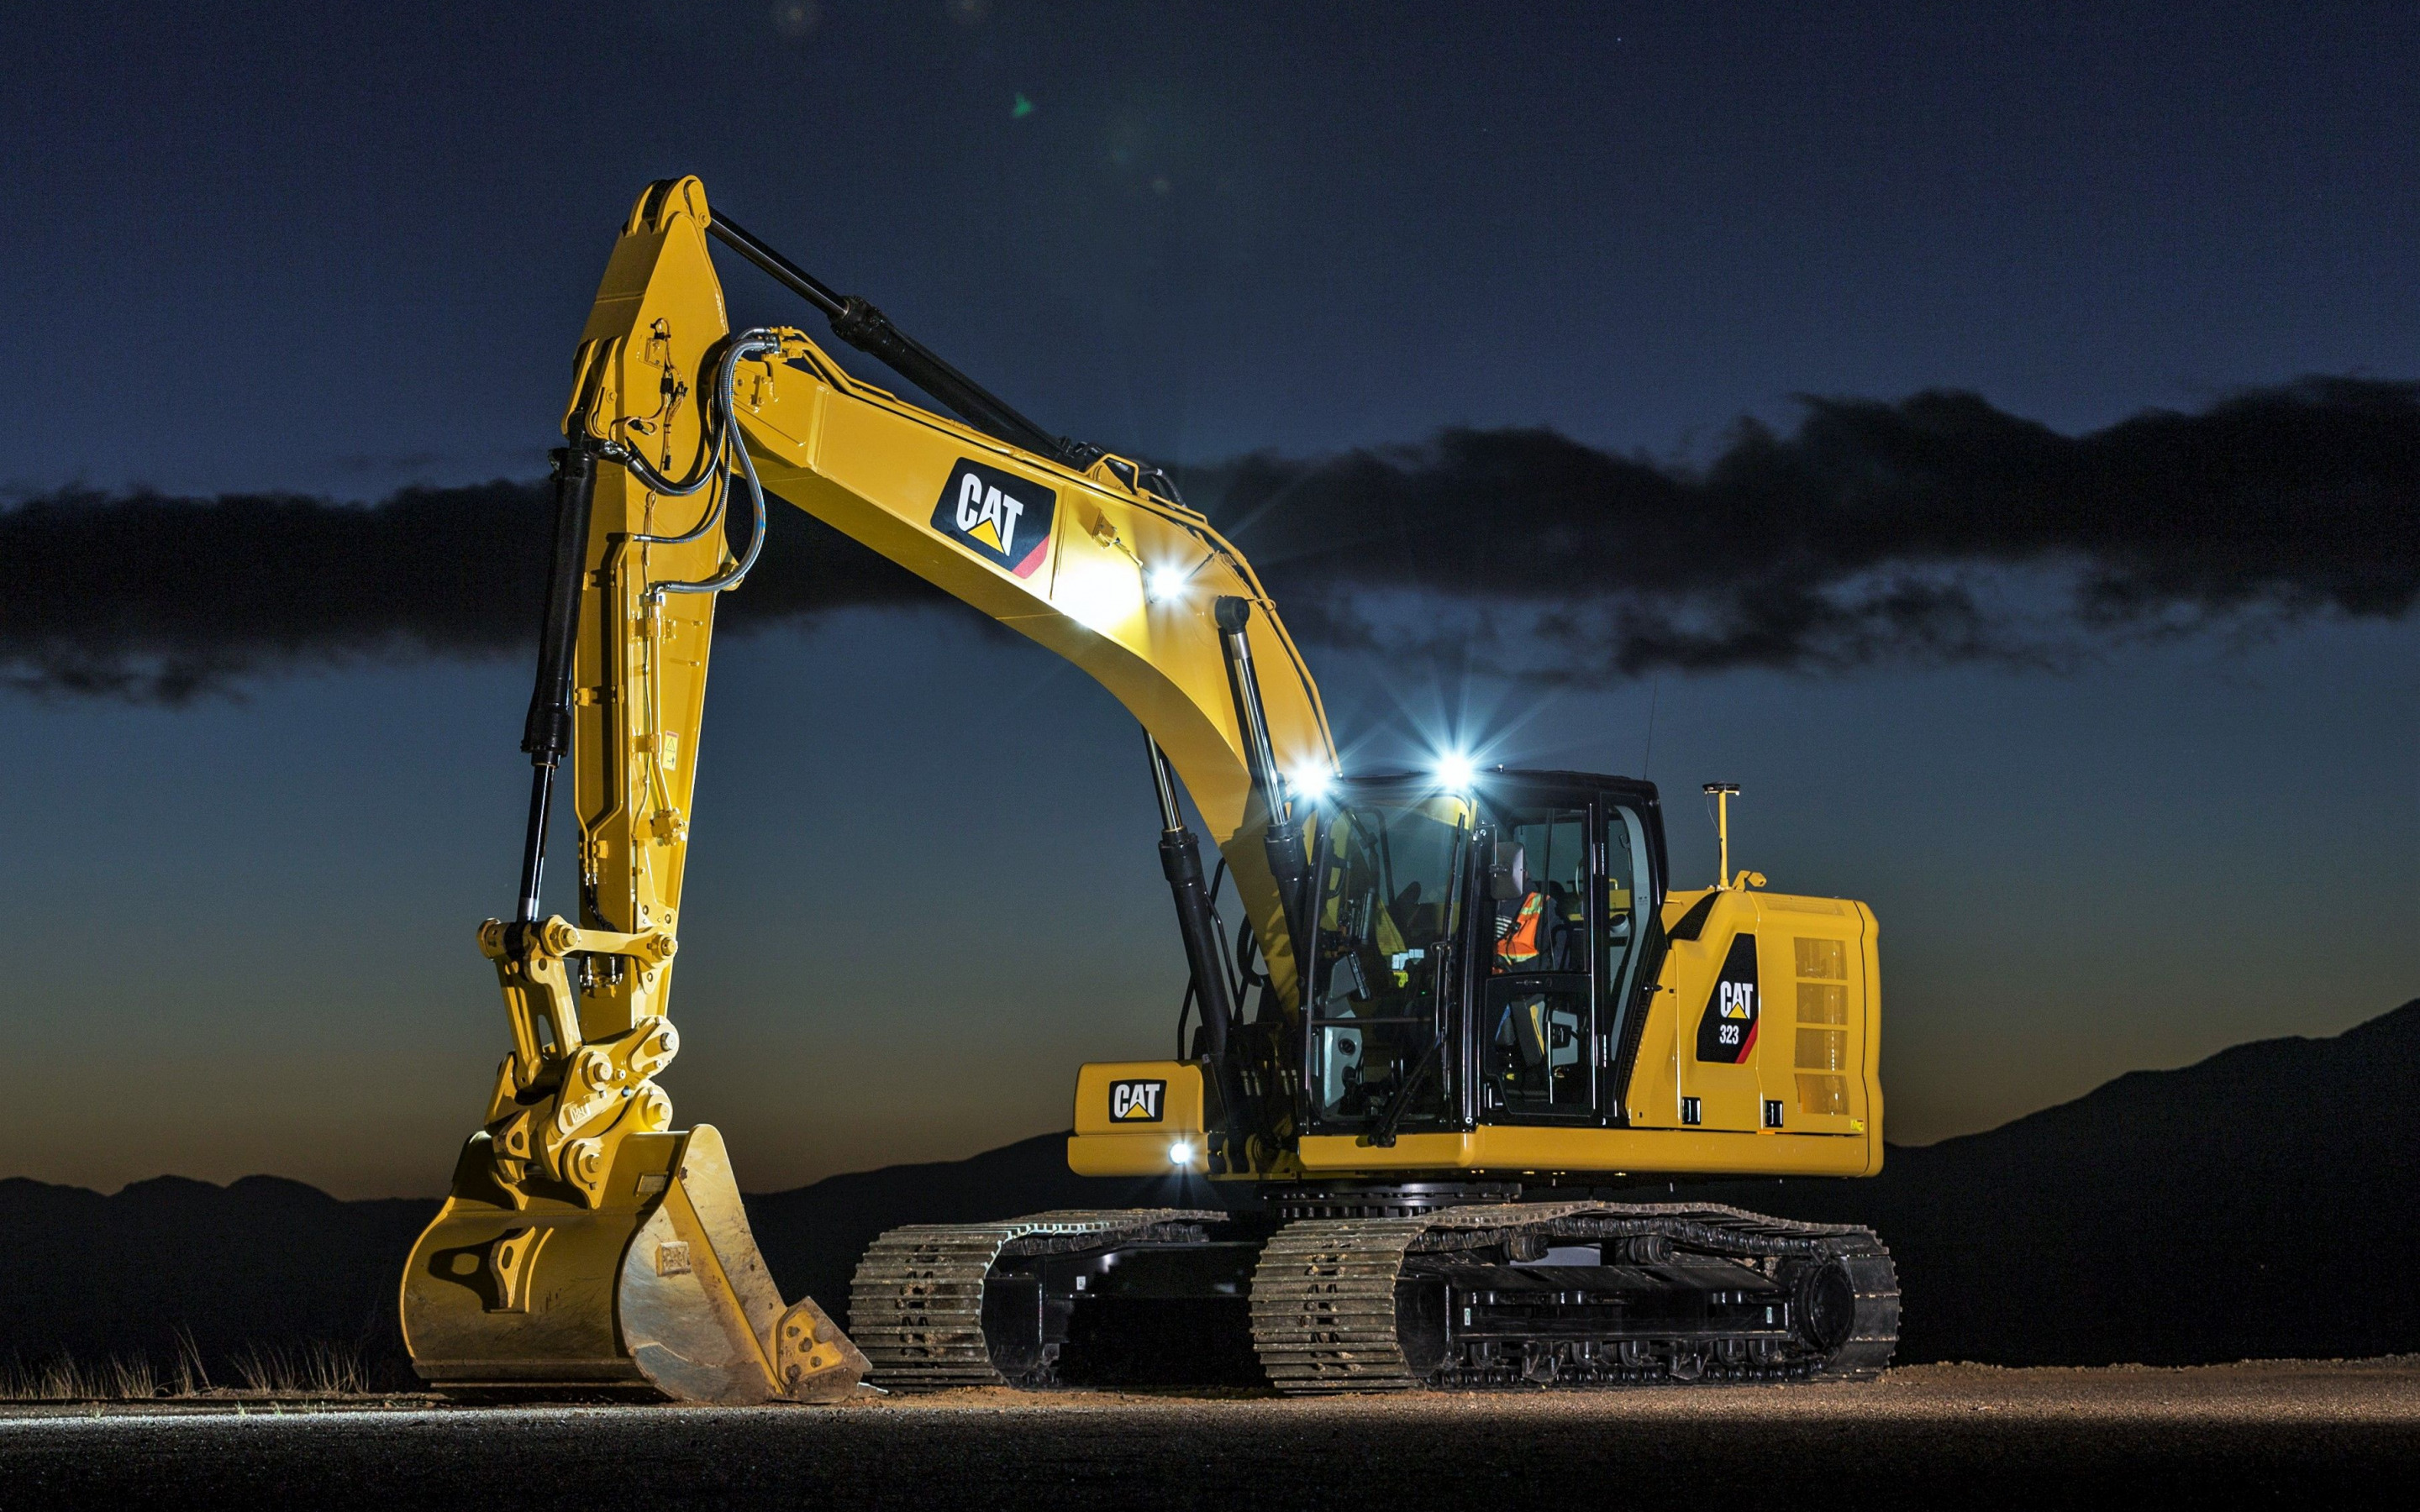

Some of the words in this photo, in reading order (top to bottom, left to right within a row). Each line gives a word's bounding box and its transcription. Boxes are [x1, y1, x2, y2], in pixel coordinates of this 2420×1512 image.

[955, 472, 1024, 557] CAT
[1719, 980, 1754, 1020] CAT
[1719, 1024, 1739, 1045] 323
[1113, 1084, 1160, 1119] CAT
